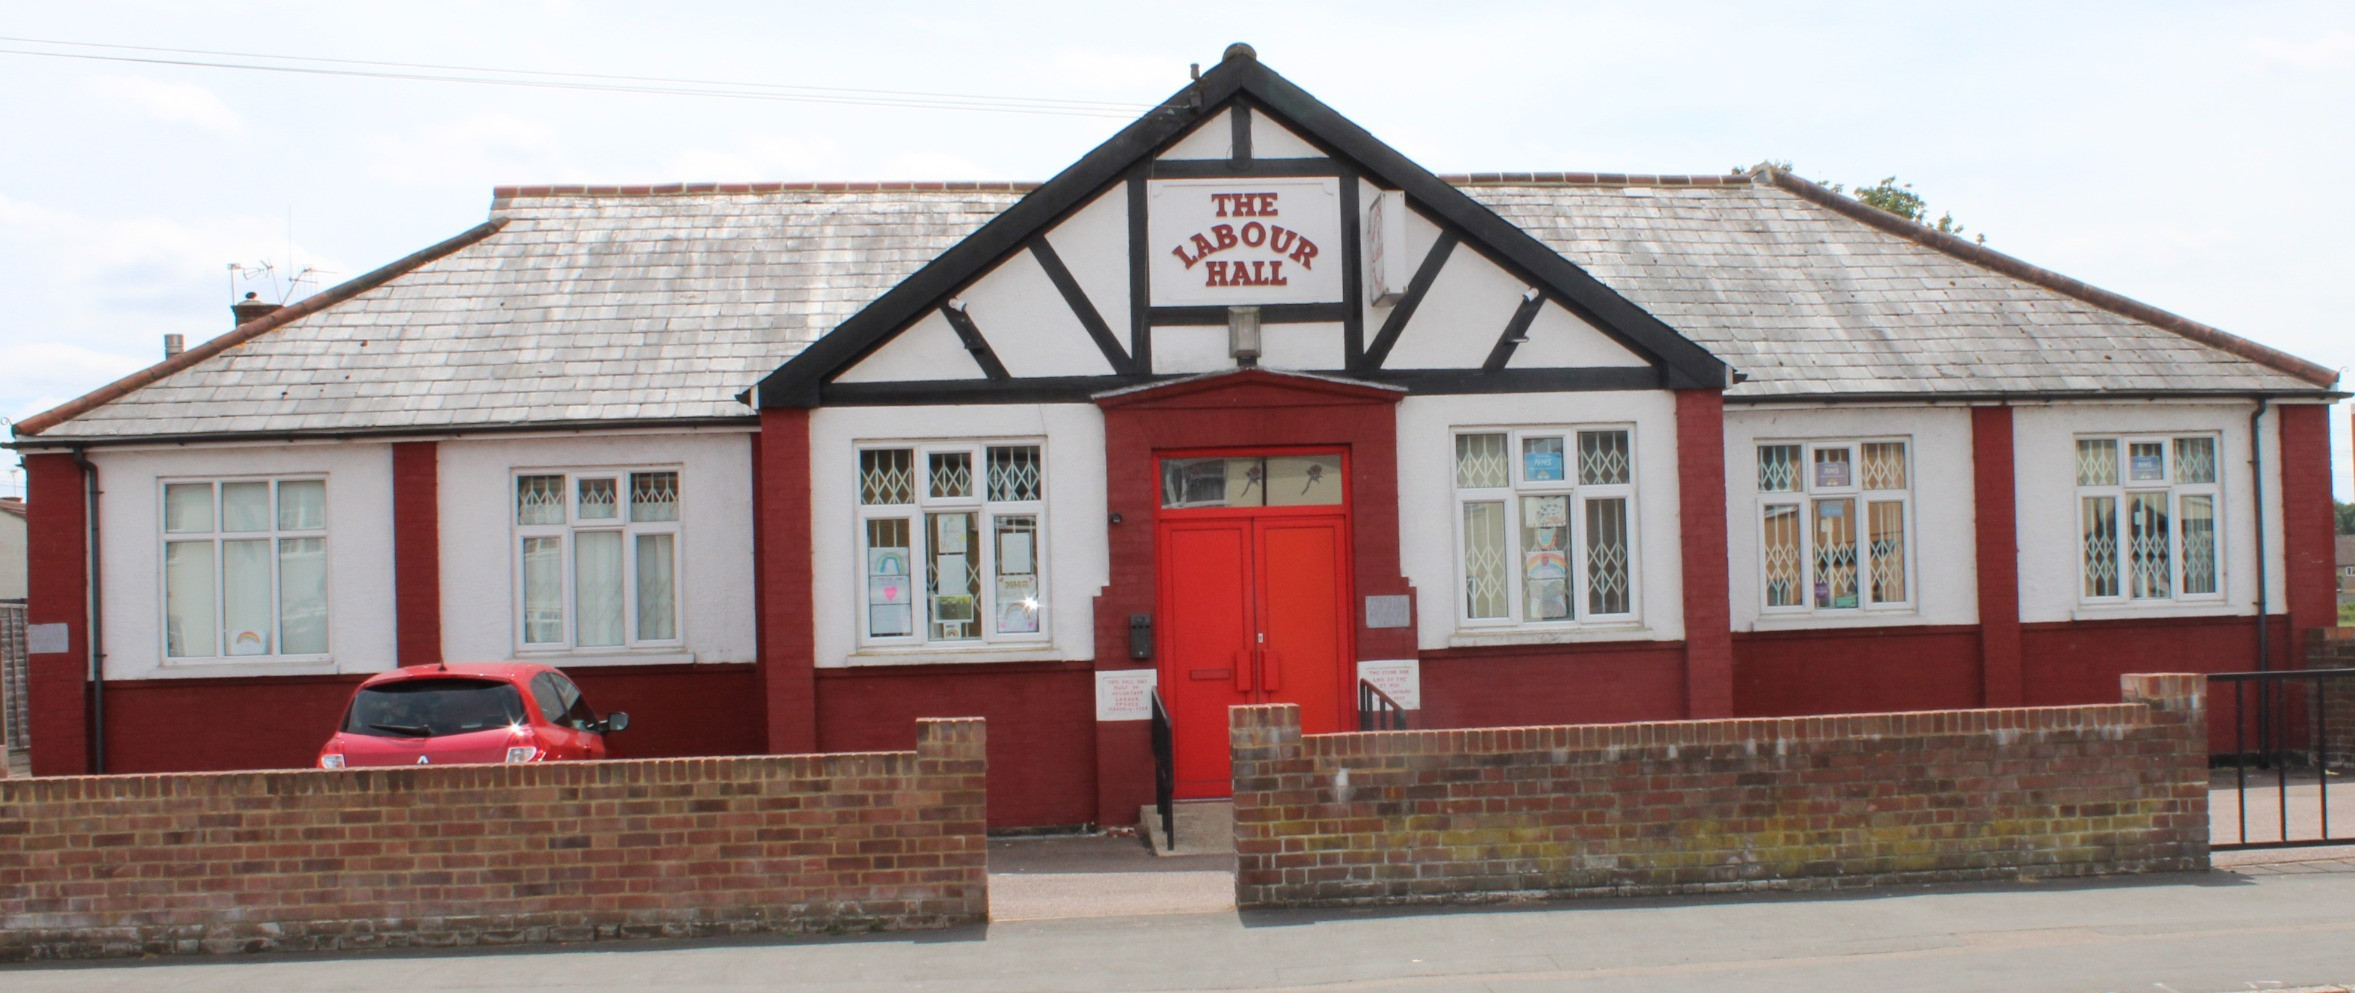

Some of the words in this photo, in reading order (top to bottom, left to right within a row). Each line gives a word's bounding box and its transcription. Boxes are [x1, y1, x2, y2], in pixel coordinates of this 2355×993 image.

[1211, 193, 1279, 217] THE
[1171, 221, 1319, 271] LABOUR
[1205, 261, 1287, 287] HALL
[1534, 458, 1552, 466] NHS
